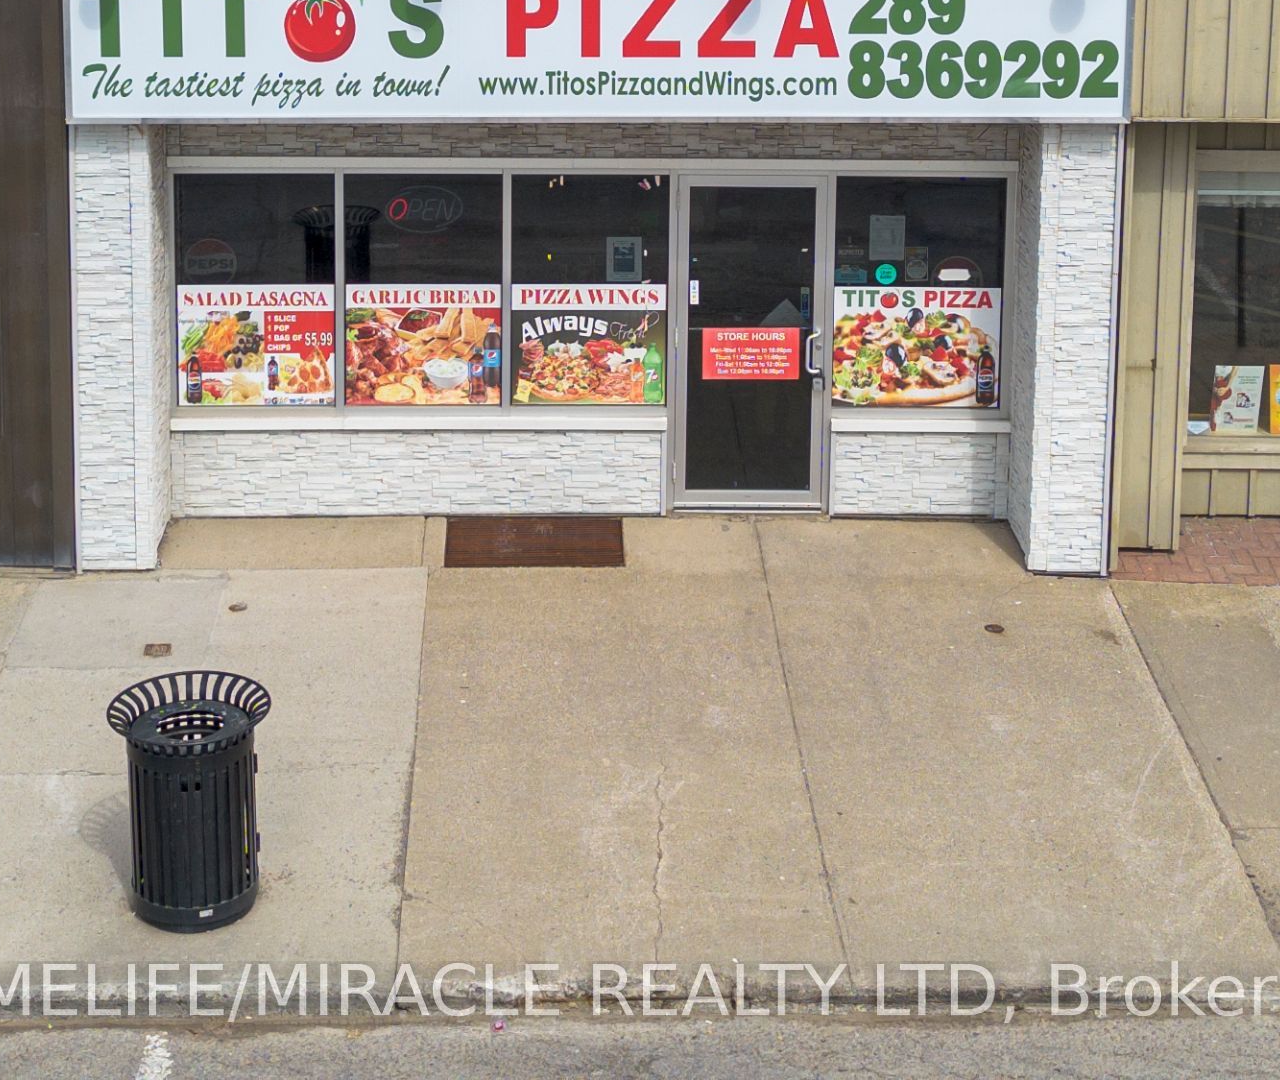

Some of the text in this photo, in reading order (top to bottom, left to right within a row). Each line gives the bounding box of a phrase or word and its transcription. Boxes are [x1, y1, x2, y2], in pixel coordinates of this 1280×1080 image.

[848, 40, 1119, 99] 8369292
[82, 63, 451, 108] The tastiest pizza in town!
[478, 70, 838, 103] www.TitosPizzaandWings.com
[389, 198, 454, 221] OPEN
[183, 291, 328, 307] SALAD LASAGNA
[352, 289, 496, 304] GARLIC BREAD
[521, 288, 659, 305] PIZZA WINGS
[924, 290, 993, 309] PIZZA
[521, 315, 609, 343] Always
[717, 332, 786, 341] STORE HOURS
[304, 332, 333, 347] $5.99
